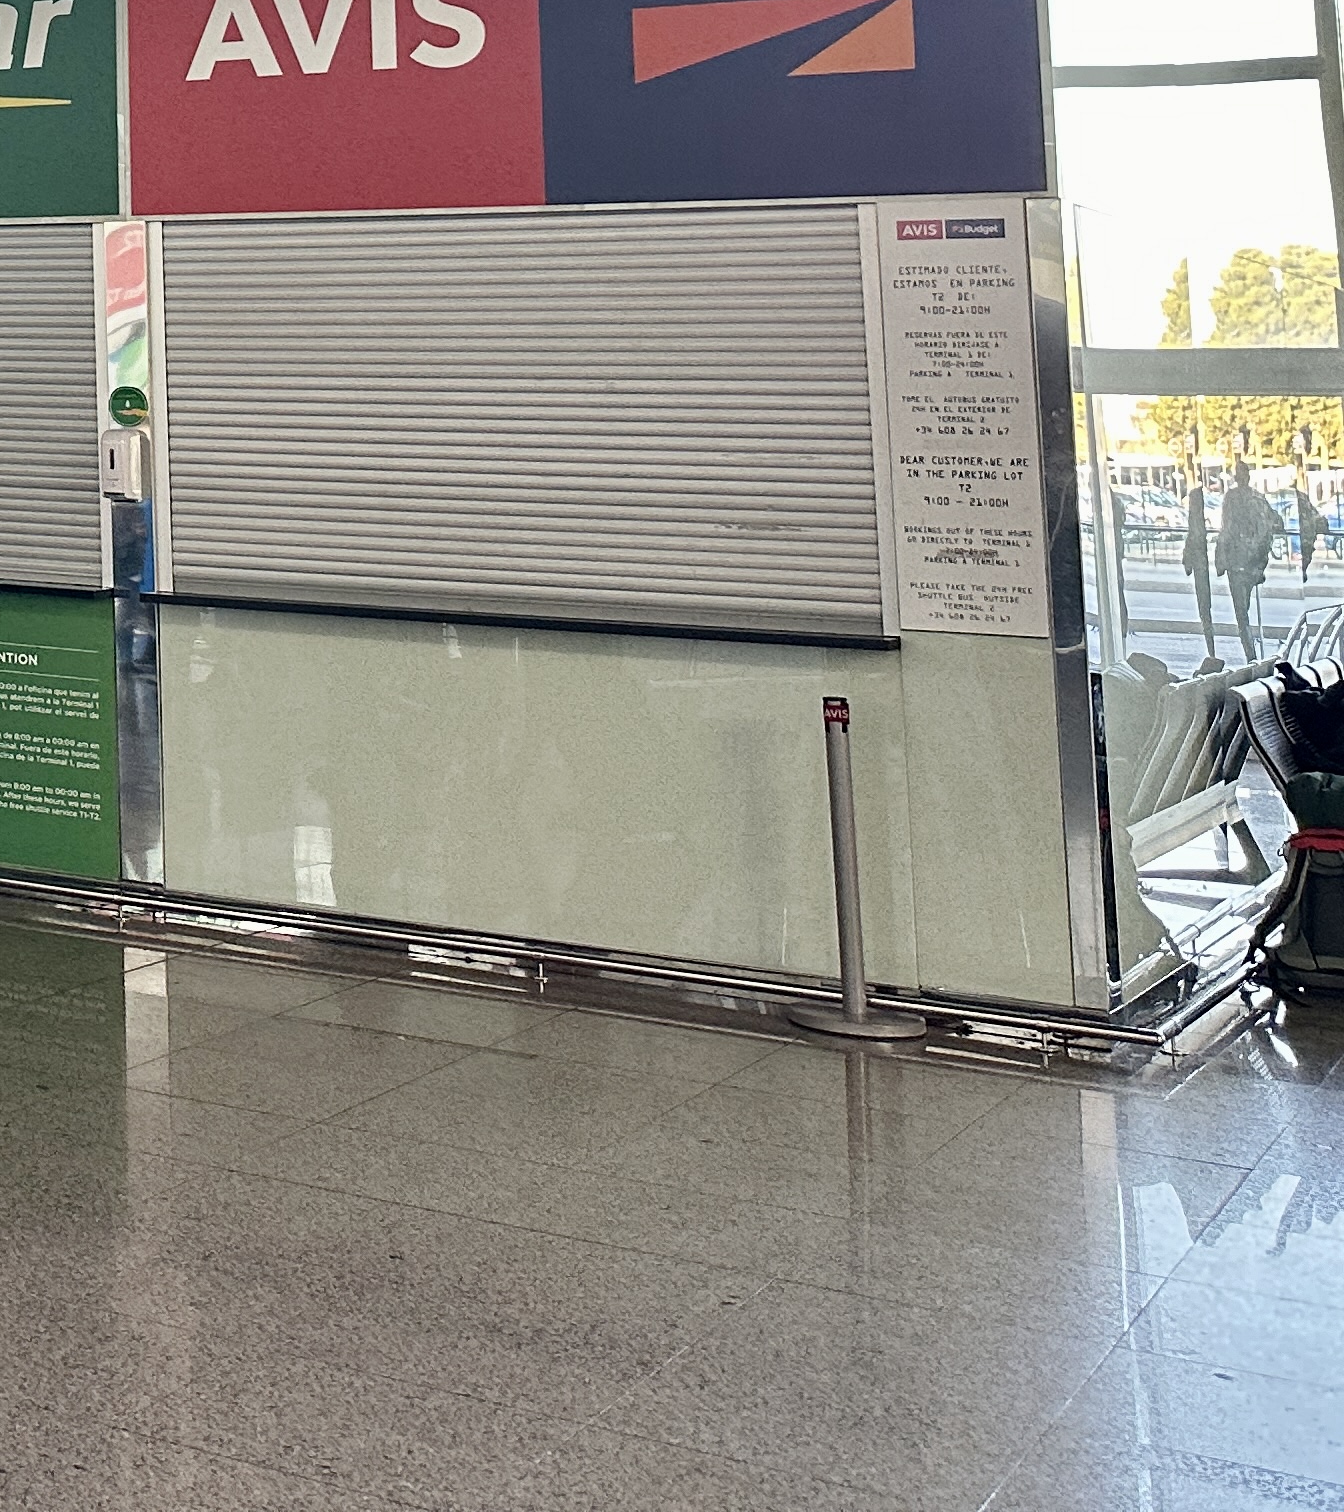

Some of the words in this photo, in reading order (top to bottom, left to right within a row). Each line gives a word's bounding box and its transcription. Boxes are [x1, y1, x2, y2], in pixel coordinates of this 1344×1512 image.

[902, 223, 938, 237] AVIS
[964, 223, 999, 235] Budget
[899, 455, 925, 465] DEAR
[1009, 457, 1030, 468] ARE
[906, 468, 920, 478] IN
[925, 469, 945, 479] THE
[951, 469, 997, 480] PARKING
[1003, 471, 1024, 481] LOT
[958, 483, 972, 493] T2
